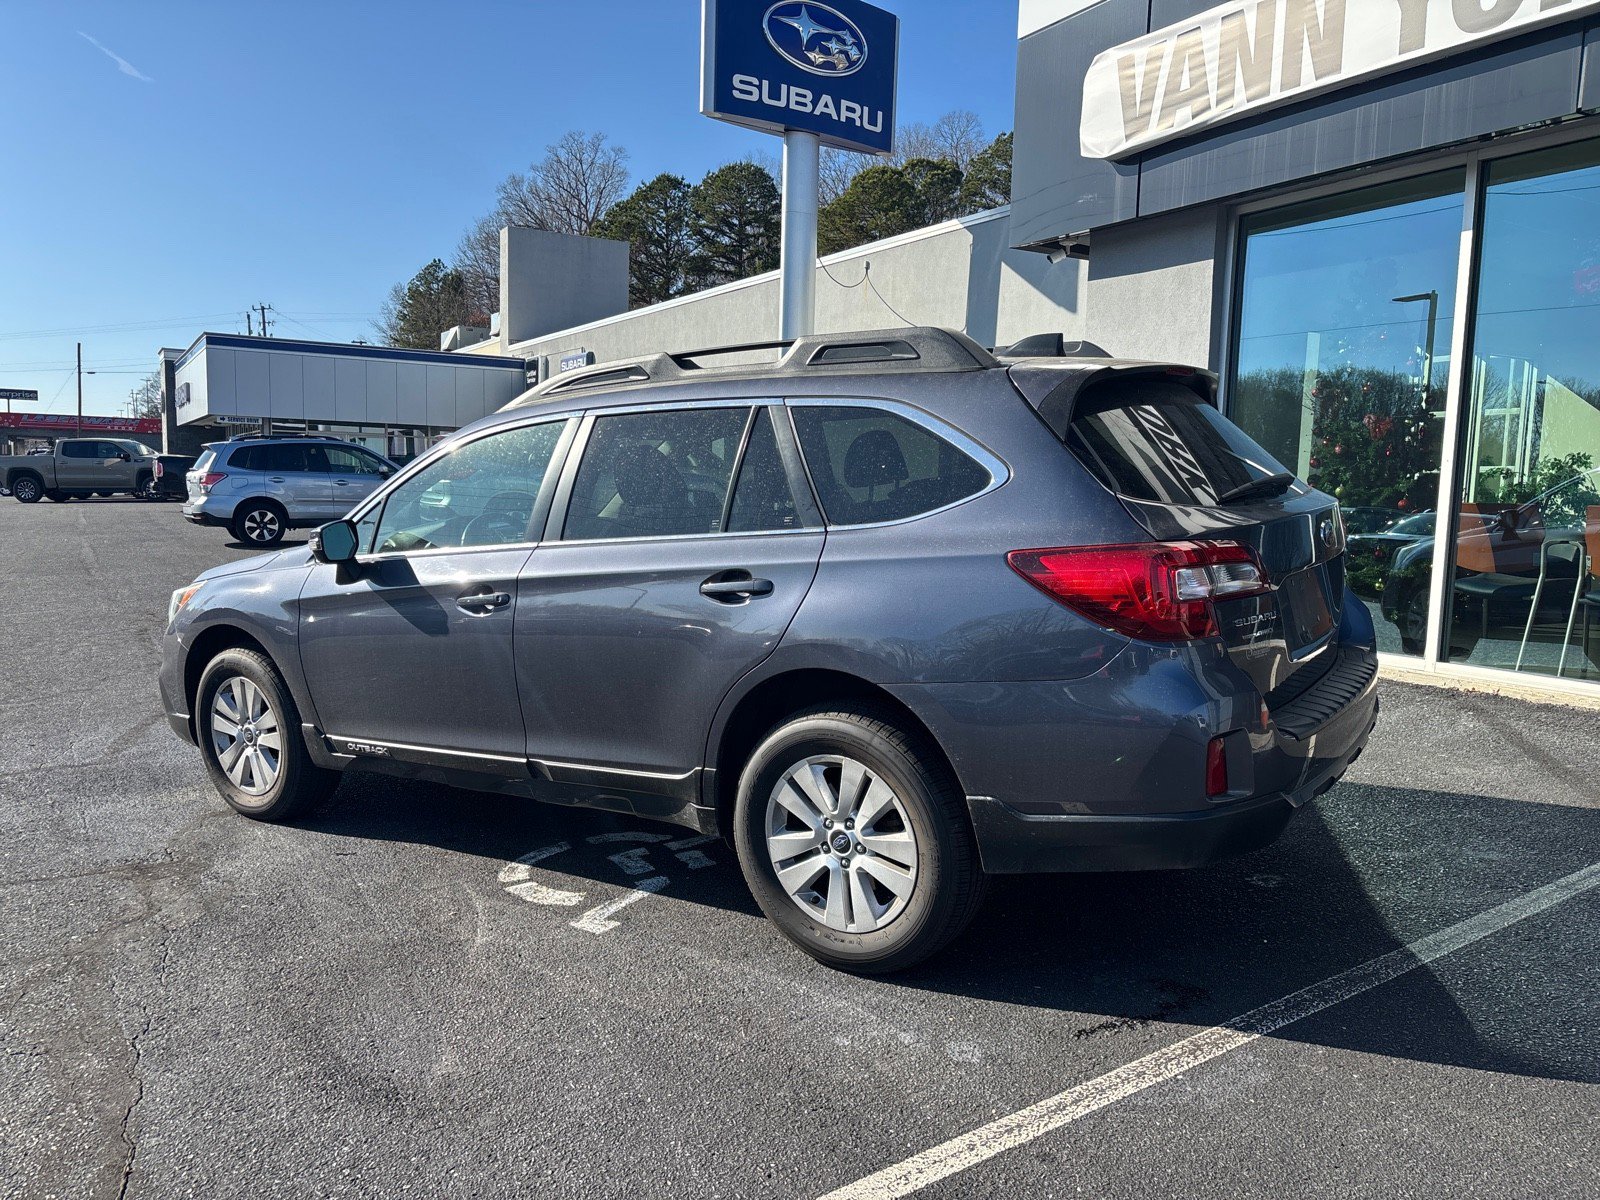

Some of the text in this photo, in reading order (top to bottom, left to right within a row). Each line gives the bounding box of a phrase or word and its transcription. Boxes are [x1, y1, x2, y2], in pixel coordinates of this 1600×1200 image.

[1117, 0, 1346, 142] VANN
[732, 74, 883, 133] SUBARU
[561, 357, 586, 371] SUBARU
[1234, 610, 1277, 627] SUBARU
[347, 743, 391, 757] OUTBACK
